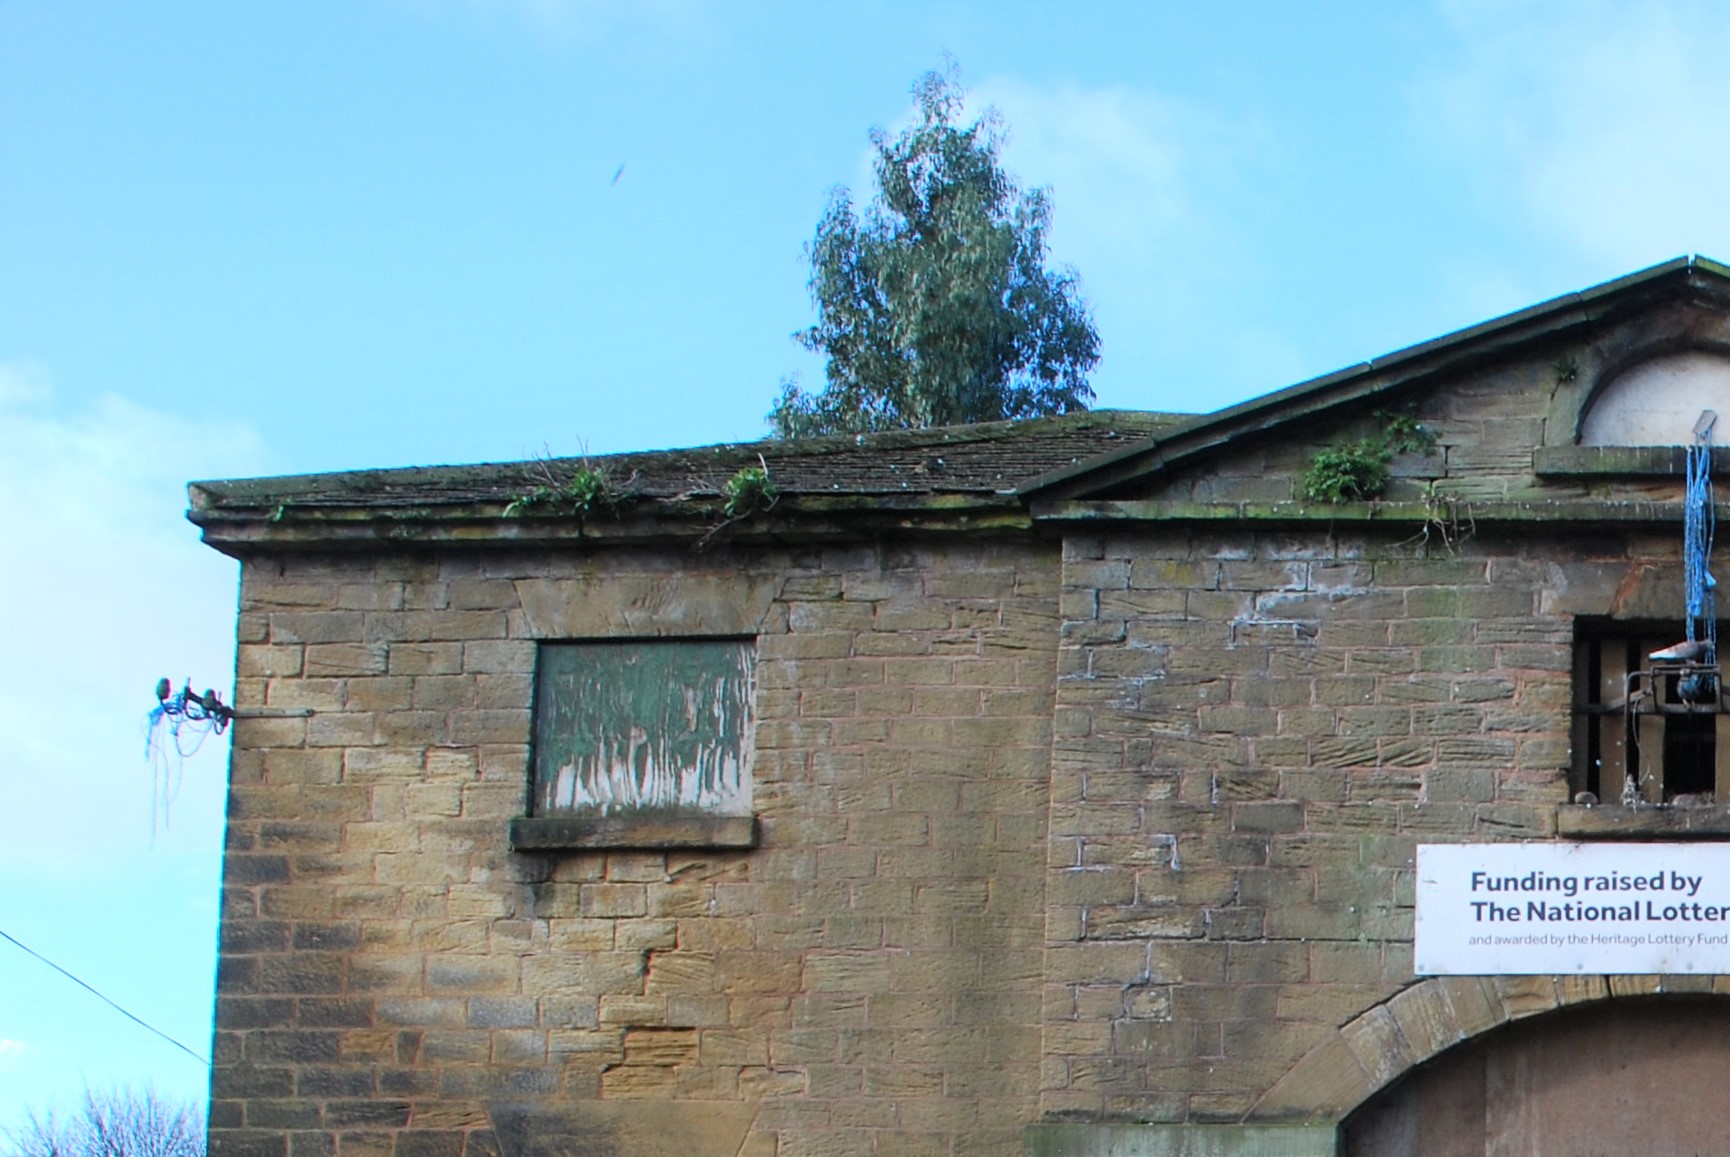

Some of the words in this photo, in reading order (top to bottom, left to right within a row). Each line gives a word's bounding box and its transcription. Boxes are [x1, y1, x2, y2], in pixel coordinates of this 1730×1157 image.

[1471, 871, 1578, 897] Funding
[1584, 871, 1665, 891] raised
[1671, 871, 1703, 896] by
[1470, 901, 1521, 922] The
[1527, 900, 1640, 922] National
[1469, 934, 1492, 945] and
[1495, 934, 1548, 945] awarded
[1550, 934, 1565, 947] by
[1567, 934, 1588, 945] the
[1591, 933, 1646, 947] Heritage
[1648, 933, 1695, 947] Lottery
[1697, 933, 1728, 945] Fund
